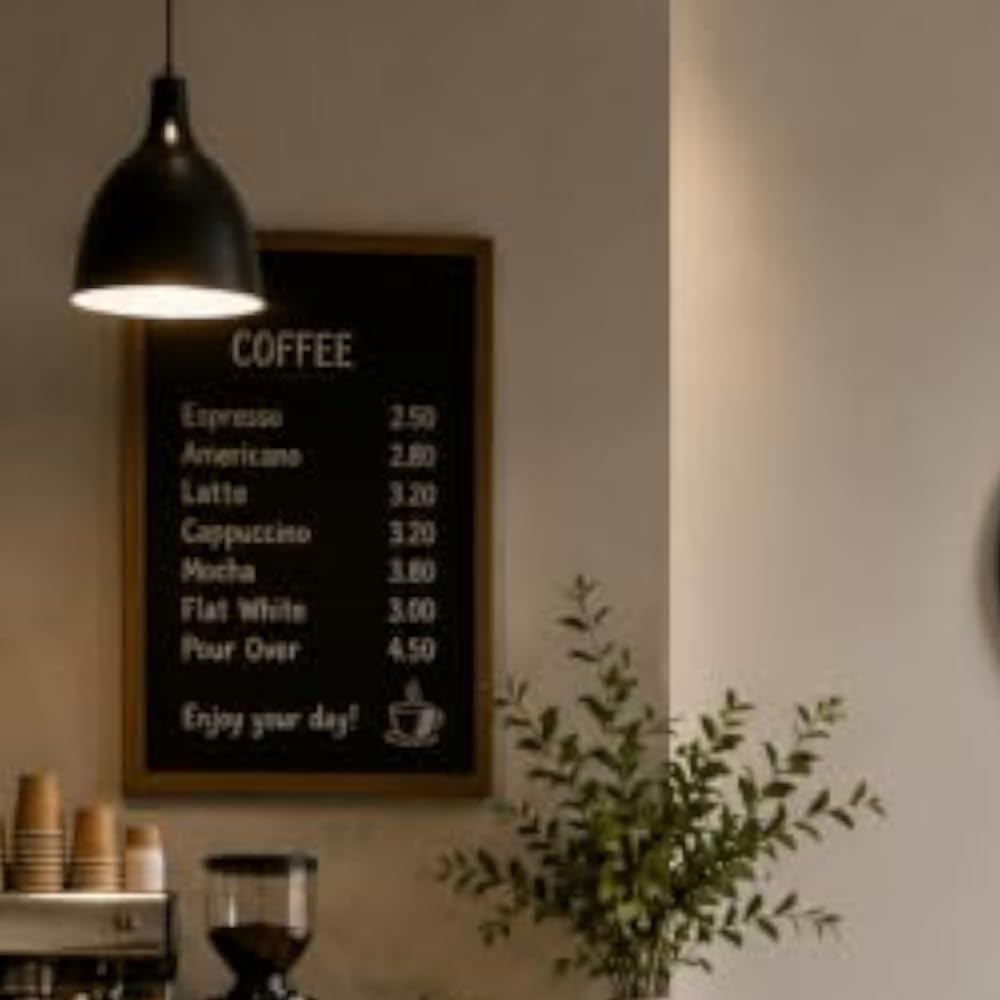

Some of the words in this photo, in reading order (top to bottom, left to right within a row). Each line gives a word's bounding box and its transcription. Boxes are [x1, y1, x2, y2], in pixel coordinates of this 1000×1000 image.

[231, 328, 354, 368] COFFEE
[180, 402, 284, 432] Espresso
[180, 441, 302, 469] Americano
[180, 479, 249, 506] Latte
[180, 517, 312, 551] Cappuccino
[388, 519, 437, 546] 3.20
[180, 557, 257, 584] Mocha
[180, 595, 228, 623] Flat
[237, 596, 308, 624] White
[180, 634, 236, 663] Pour
[244, 636, 301, 663] Over
[180, 701, 245, 740] Enjoy
[251, 711, 302, 740] your
[308, 703, 360, 740] day!
